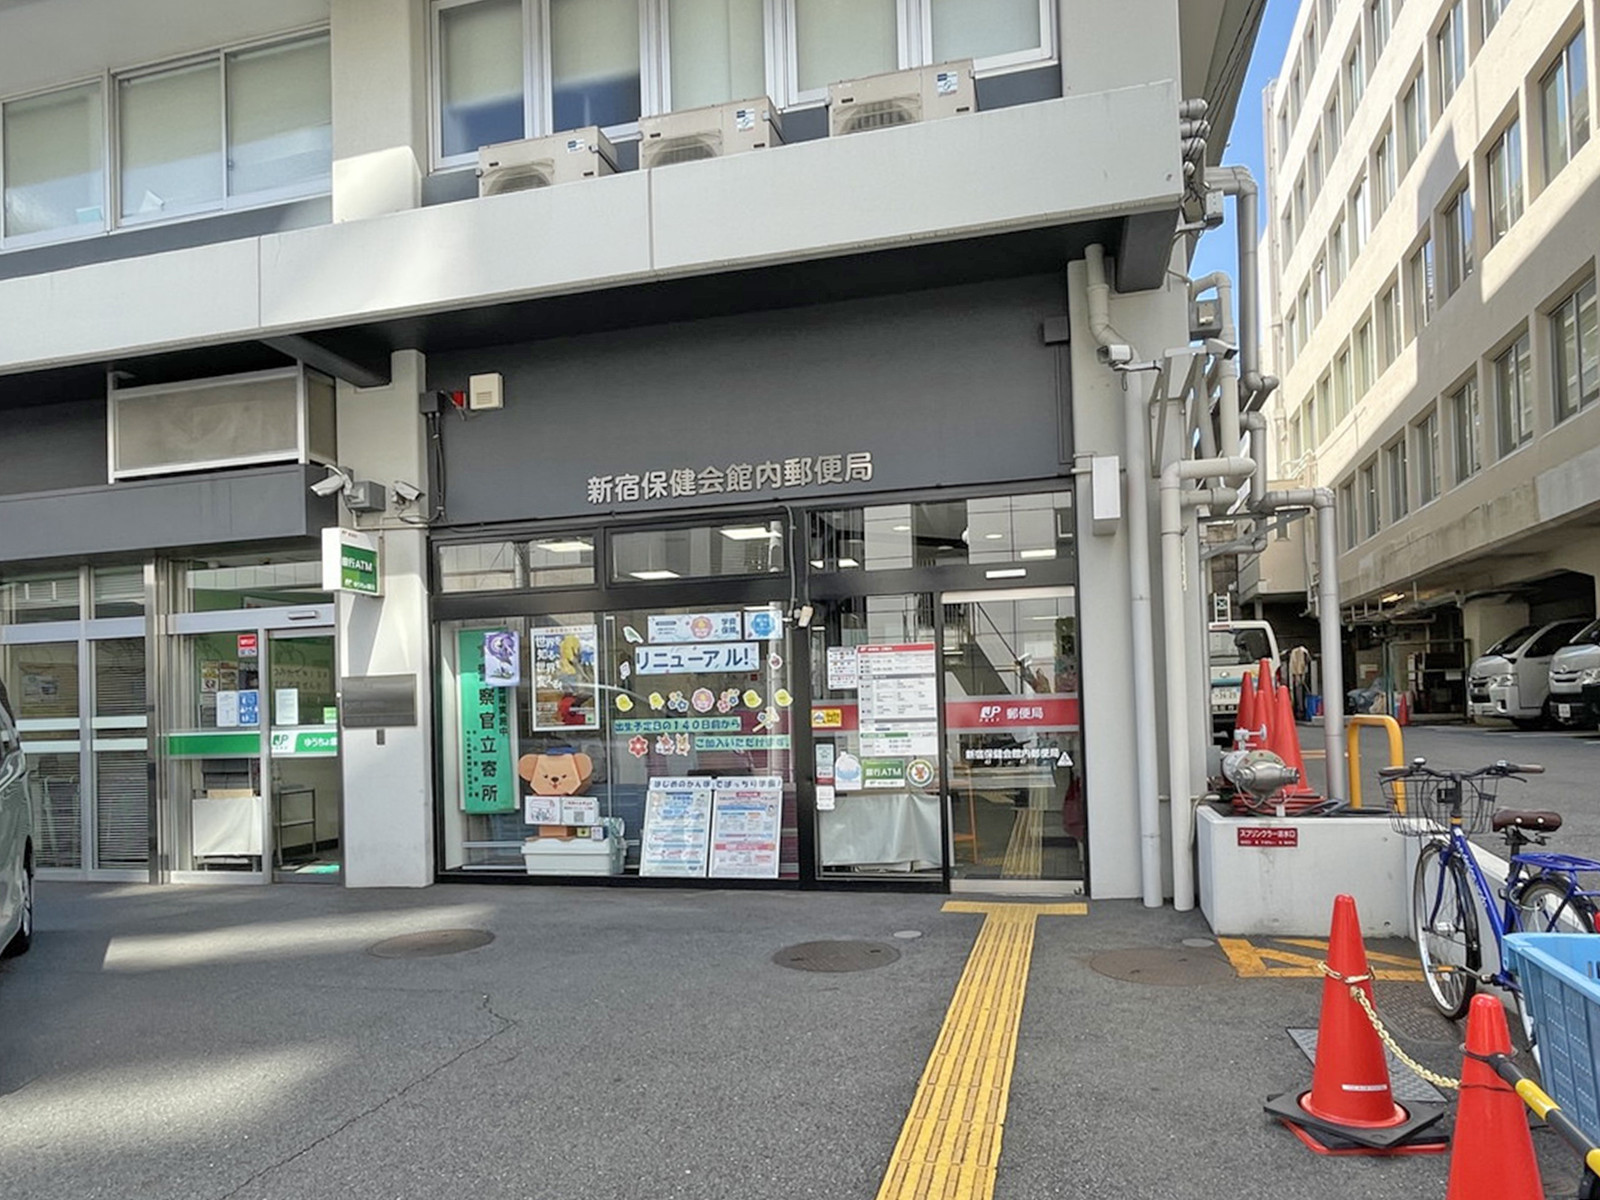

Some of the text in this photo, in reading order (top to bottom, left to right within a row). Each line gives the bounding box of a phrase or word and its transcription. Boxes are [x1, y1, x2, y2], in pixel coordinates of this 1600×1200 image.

[587, 451, 874, 504] 新宿保健会館内郵便局
[636, 647, 749, 670] リニューアル!
[1006, 706, 1045, 721] 郵便局
